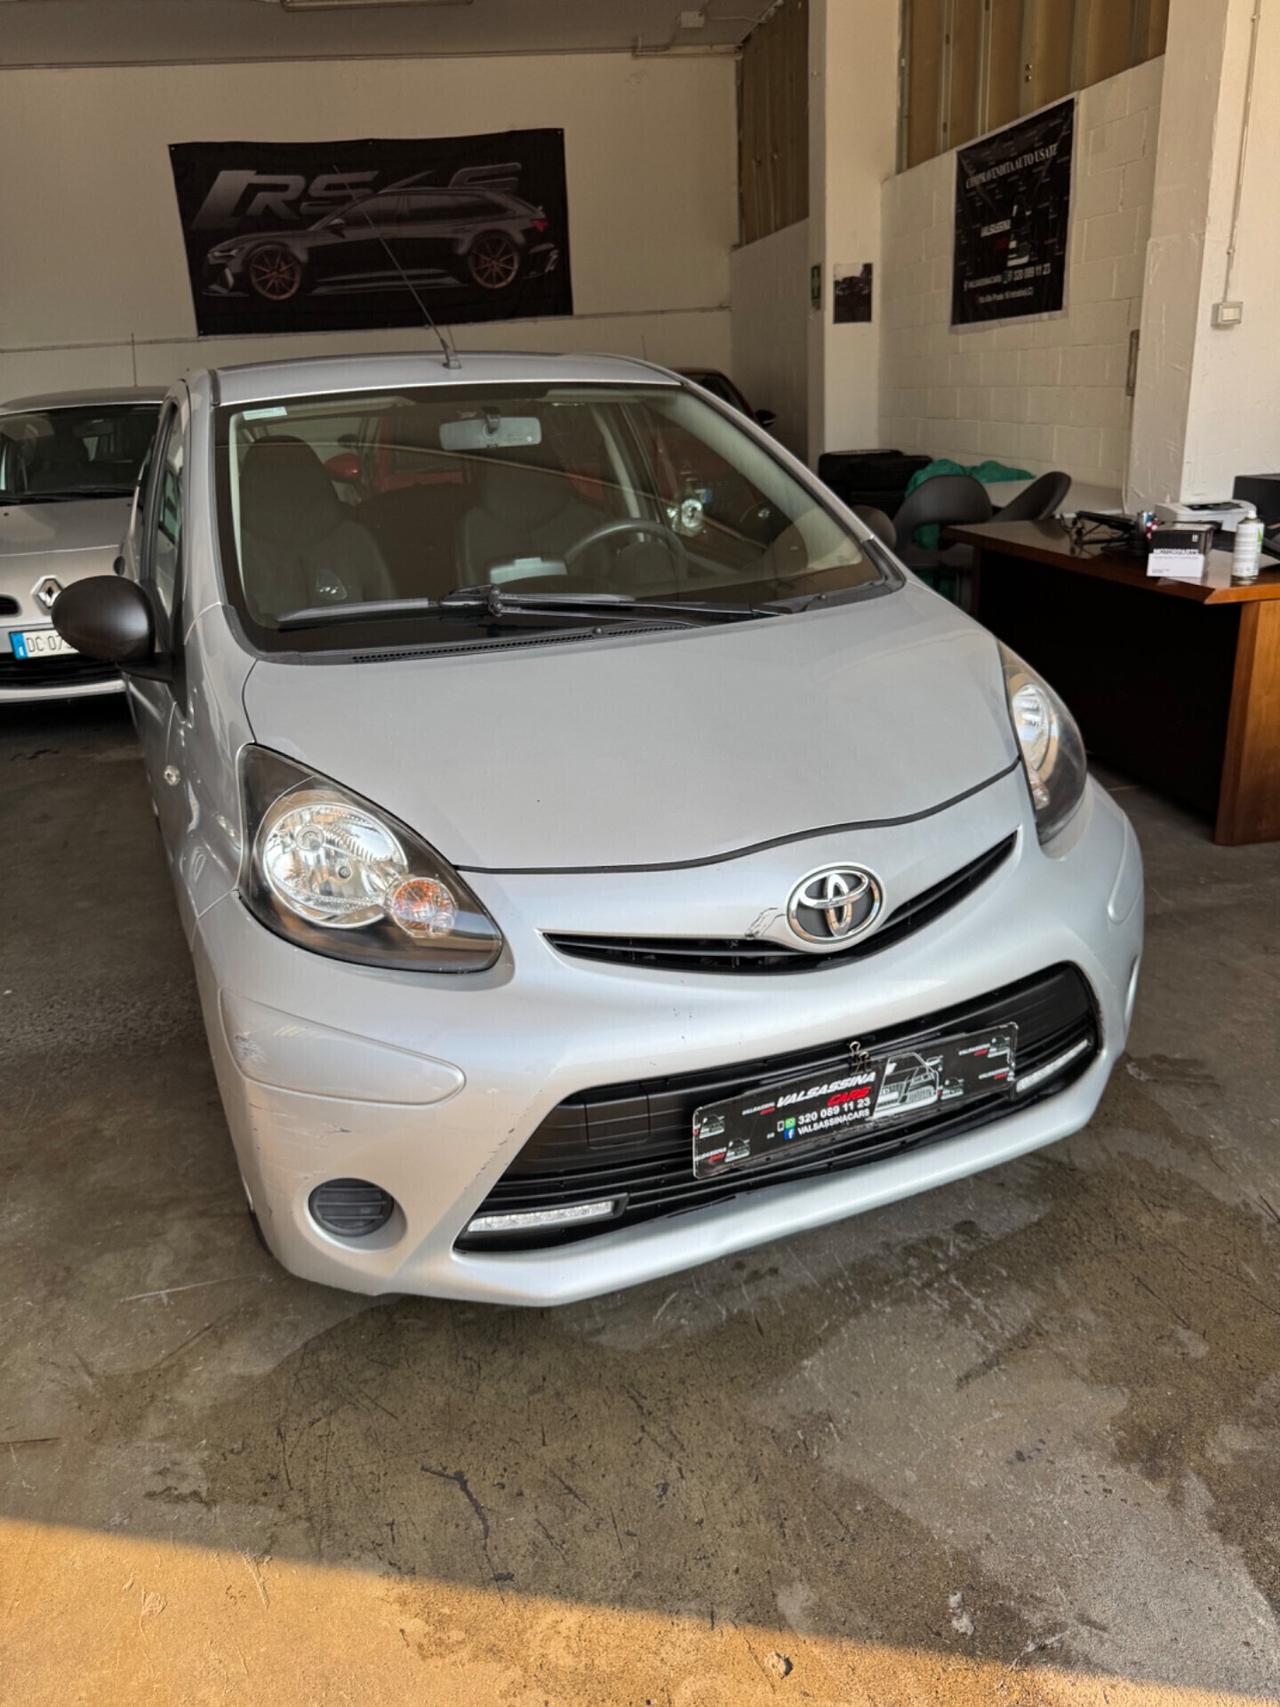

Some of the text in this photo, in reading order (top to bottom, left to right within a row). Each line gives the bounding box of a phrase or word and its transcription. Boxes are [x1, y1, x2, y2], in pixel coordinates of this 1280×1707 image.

[26, 636, 44, 653] DC
[777, 1072, 876, 1108] VALSASSINA
[797, 1107, 871, 1136] VALSASSINACARS
[798, 1096, 871, 1125] 320 089 11 23
